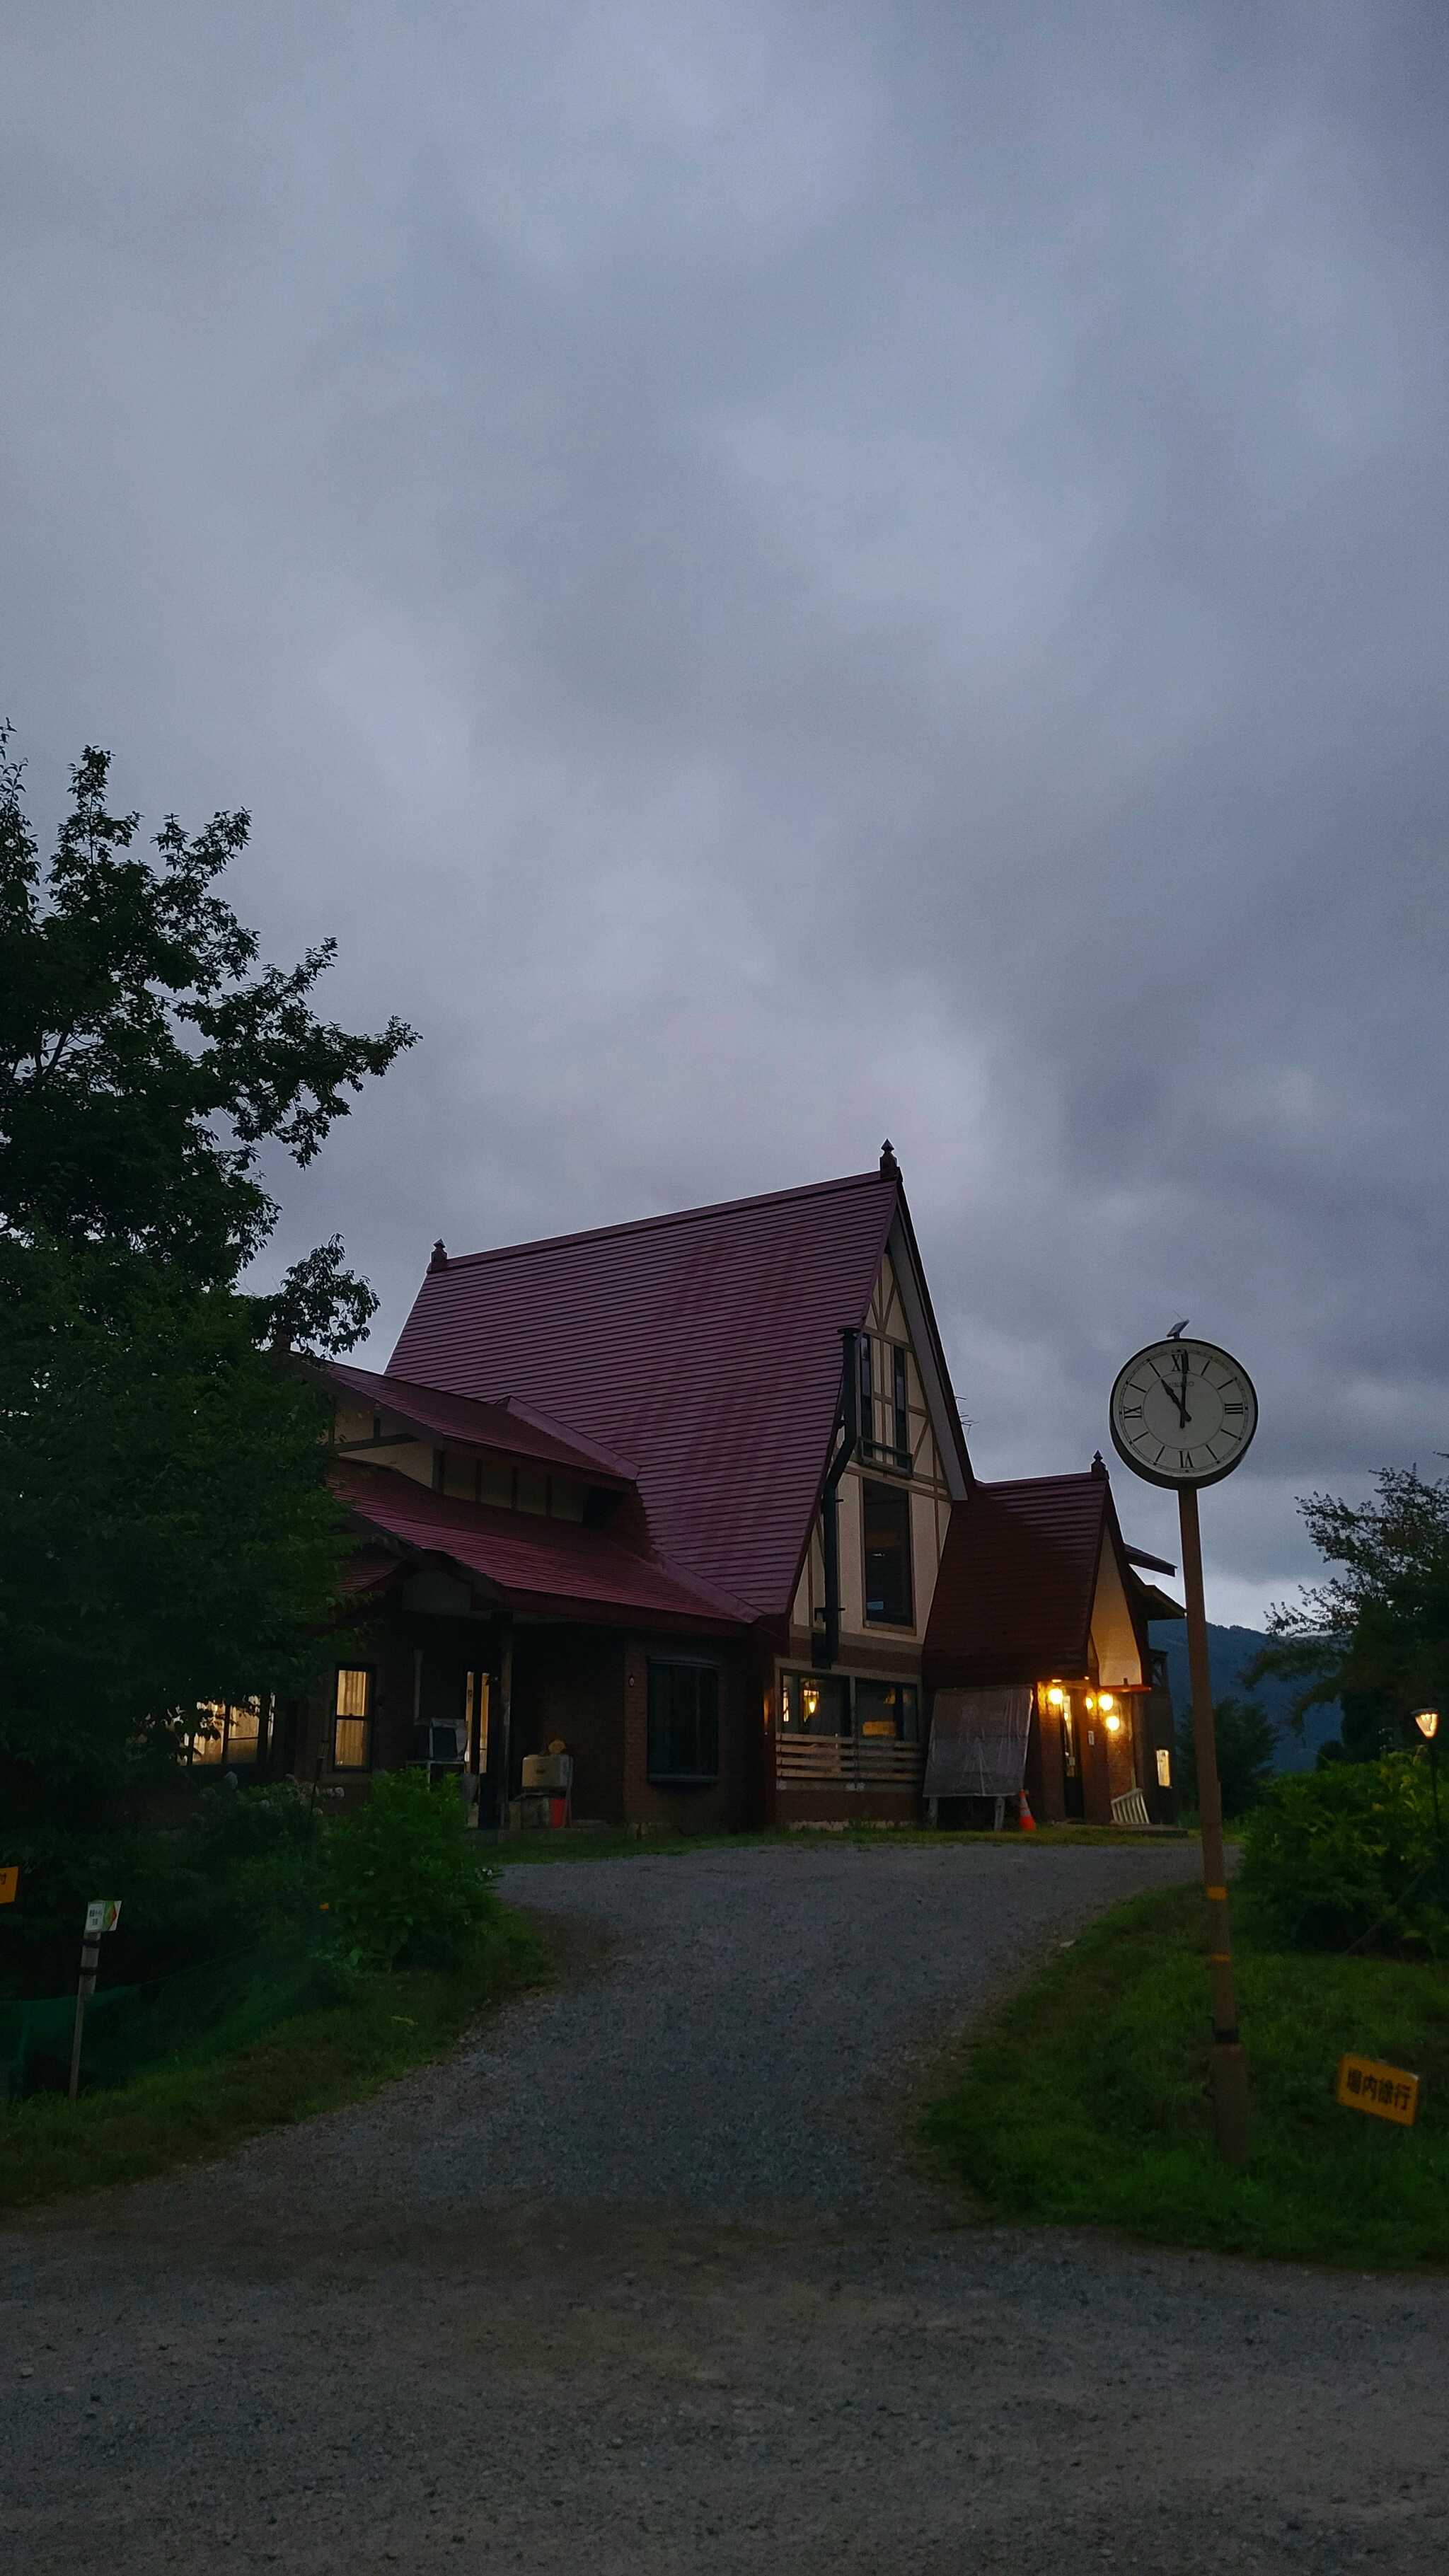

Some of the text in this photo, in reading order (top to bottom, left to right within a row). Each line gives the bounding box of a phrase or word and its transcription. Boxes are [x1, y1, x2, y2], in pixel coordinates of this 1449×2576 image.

[1124, 1405, 1142, 1419] IX
[1224, 1403, 1243, 1414] III
[1179, 1450, 1194, 1468] VI
